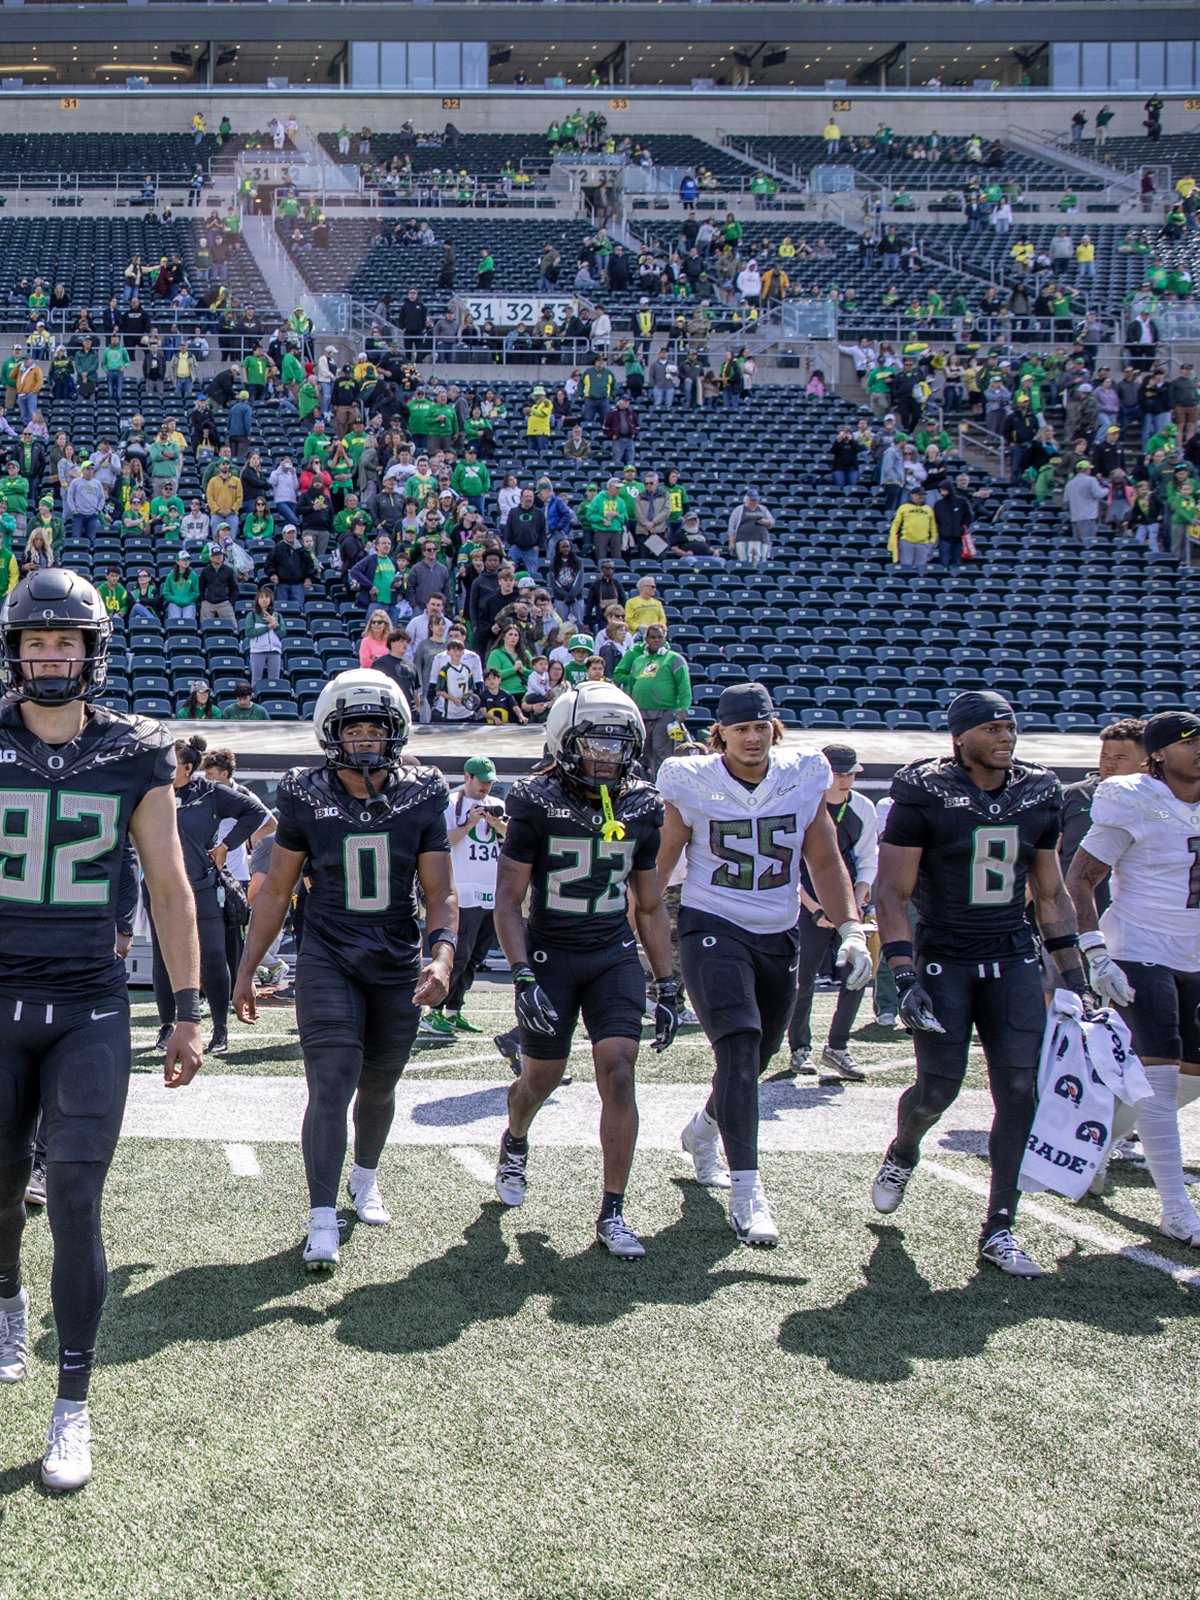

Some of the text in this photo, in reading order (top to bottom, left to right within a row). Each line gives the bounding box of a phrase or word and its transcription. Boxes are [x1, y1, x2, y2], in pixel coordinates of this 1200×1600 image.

[63, 99, 77, 108] 31
[444, 99, 458, 109] 32
[612, 99, 627, 109] 33
[469, 303, 494, 321] 31
[507, 303, 533, 321] 32
[47, 755, 64, 770] O
[990, 803, 1001, 814] O
[360, 811, 372, 823] O
[469, 844, 499, 861] 134
[709, 814, 798, 890] 55
[343, 832, 391, 913] 0
[969, 825, 1020, 906] 8
[546, 836, 637, 915] 23
[703, 936, 717, 947] O
[926, 963, 942, 977] O
